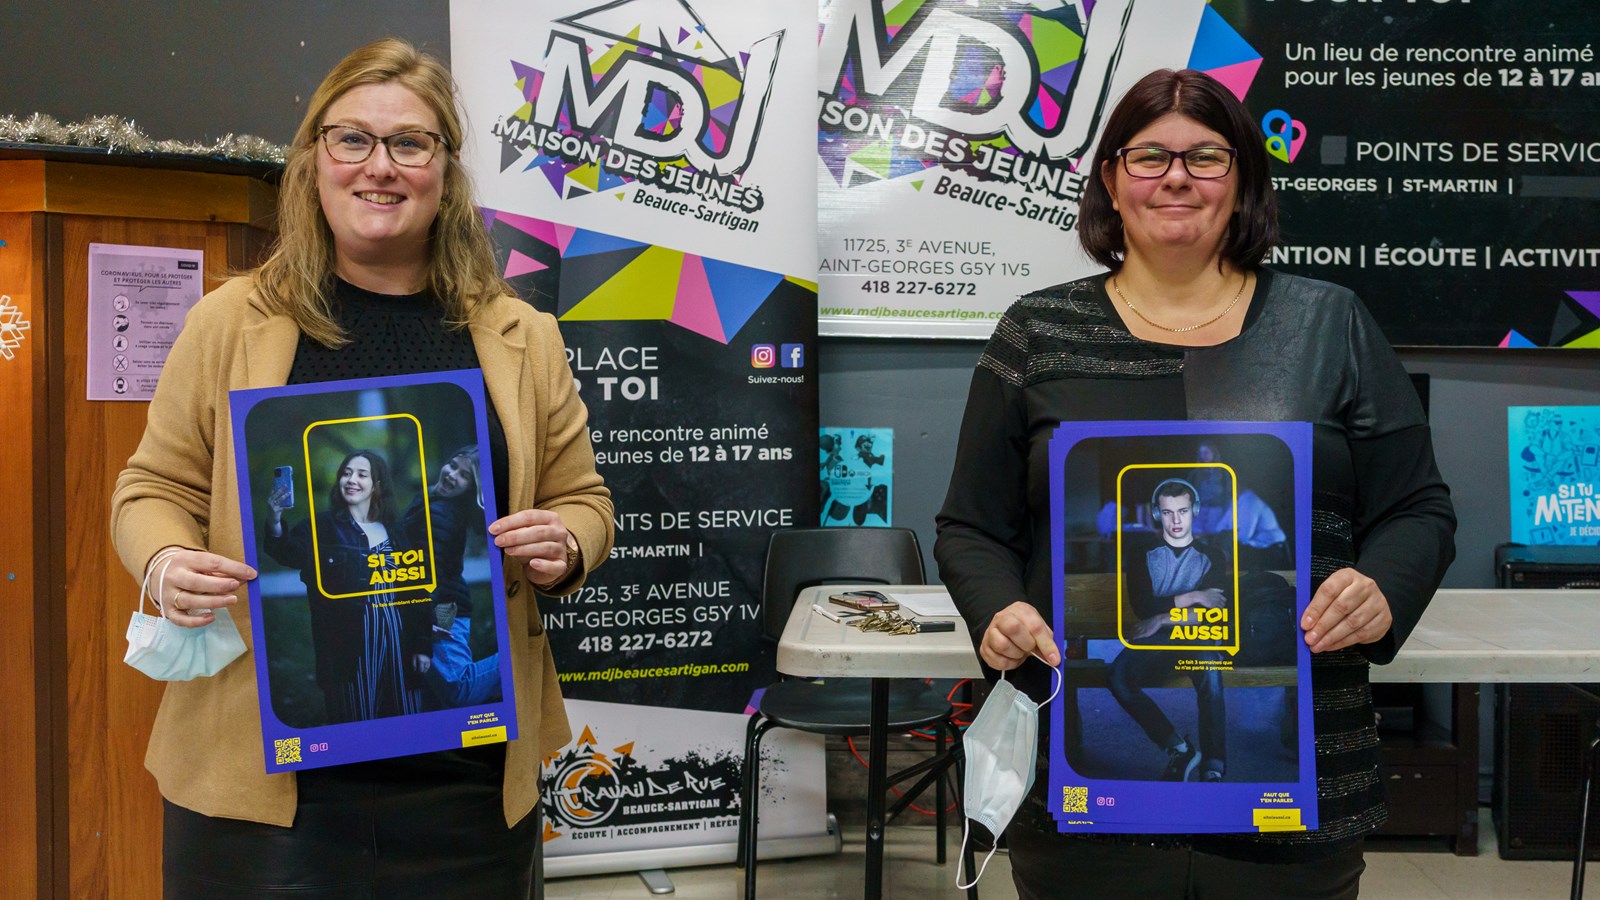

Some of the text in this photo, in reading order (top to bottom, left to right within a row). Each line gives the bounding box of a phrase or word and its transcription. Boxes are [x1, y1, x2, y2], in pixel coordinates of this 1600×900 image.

[1285, 43, 1593, 62] Un lieu de rencontre animé
[1285, 70, 1338, 88] pour
[1345, 68, 1375, 86] les
[1382, 68, 1456, 89] jeunes
[1463, 69, 1492, 87] de
[1498, 69, 1523, 87] 12
[1529, 68, 1544, 87] à
[1550, 69, 1575, 87] 17
[532, 28, 787, 177] MDJ
[900, 123, 969, 163] DES
[1356, 142, 1453, 162] POINTS
[1463, 142, 1498, 162] DE
[497, 118, 761, 209] MAISON DES JEUNES
[1271, 177, 1377, 191] ST-GEORGES
[1402, 178, 1497, 193] ST-MARTIN
[633, 188, 760, 233] Beauce-Sartigan
[934, 175, 1079, 232] Beauce-Sartig
[843, 238, 890, 254] 11725,
[918, 240, 996, 257] AVENUE,
[1375, 243, 1476, 267] ÉCOUTE
[1500, 248, 1600, 267] ACTIVIT
[819, 258, 1031, 277] AINT-GEORGES G5Y 1V5
[122, 277, 151, 285] PROTÉGER
[861, 280, 976, 295] 418 227-6272
[597, 376, 658, 401] TOI
[748, 375, 804, 384] Suivez-nous!
[609, 425, 703, 442] rencontre
[710, 423, 768, 441] animé
[595, 444, 793, 464] eunes de 12 à 17 ans
[1558, 482, 1593, 499] SI TU
[661, 511, 690, 530] DE
[698, 508, 793, 528] SERVICE
[1535, 494, 1600, 526] M'TEN
[367, 549, 424, 568] SI TOI
[609, 544, 690, 559] ST-MARTIN
[369, 565, 426, 585] AUSSI
[646, 581, 730, 600] AVENUE
[543, 604, 760, 630] INT-GEORGES G5Y 1V
[1169, 607, 1229, 623] SI TOI
[578, 631, 713, 653] 418 227-6272
[1169, 625, 1229, 640] AUSSI
[623, 799, 721, 815] BEAUCE-SARTIGAN
[571, 830, 607, 840] ÉCOUTE
[617, 822, 700, 836] ACCOMPAGNEMENT
